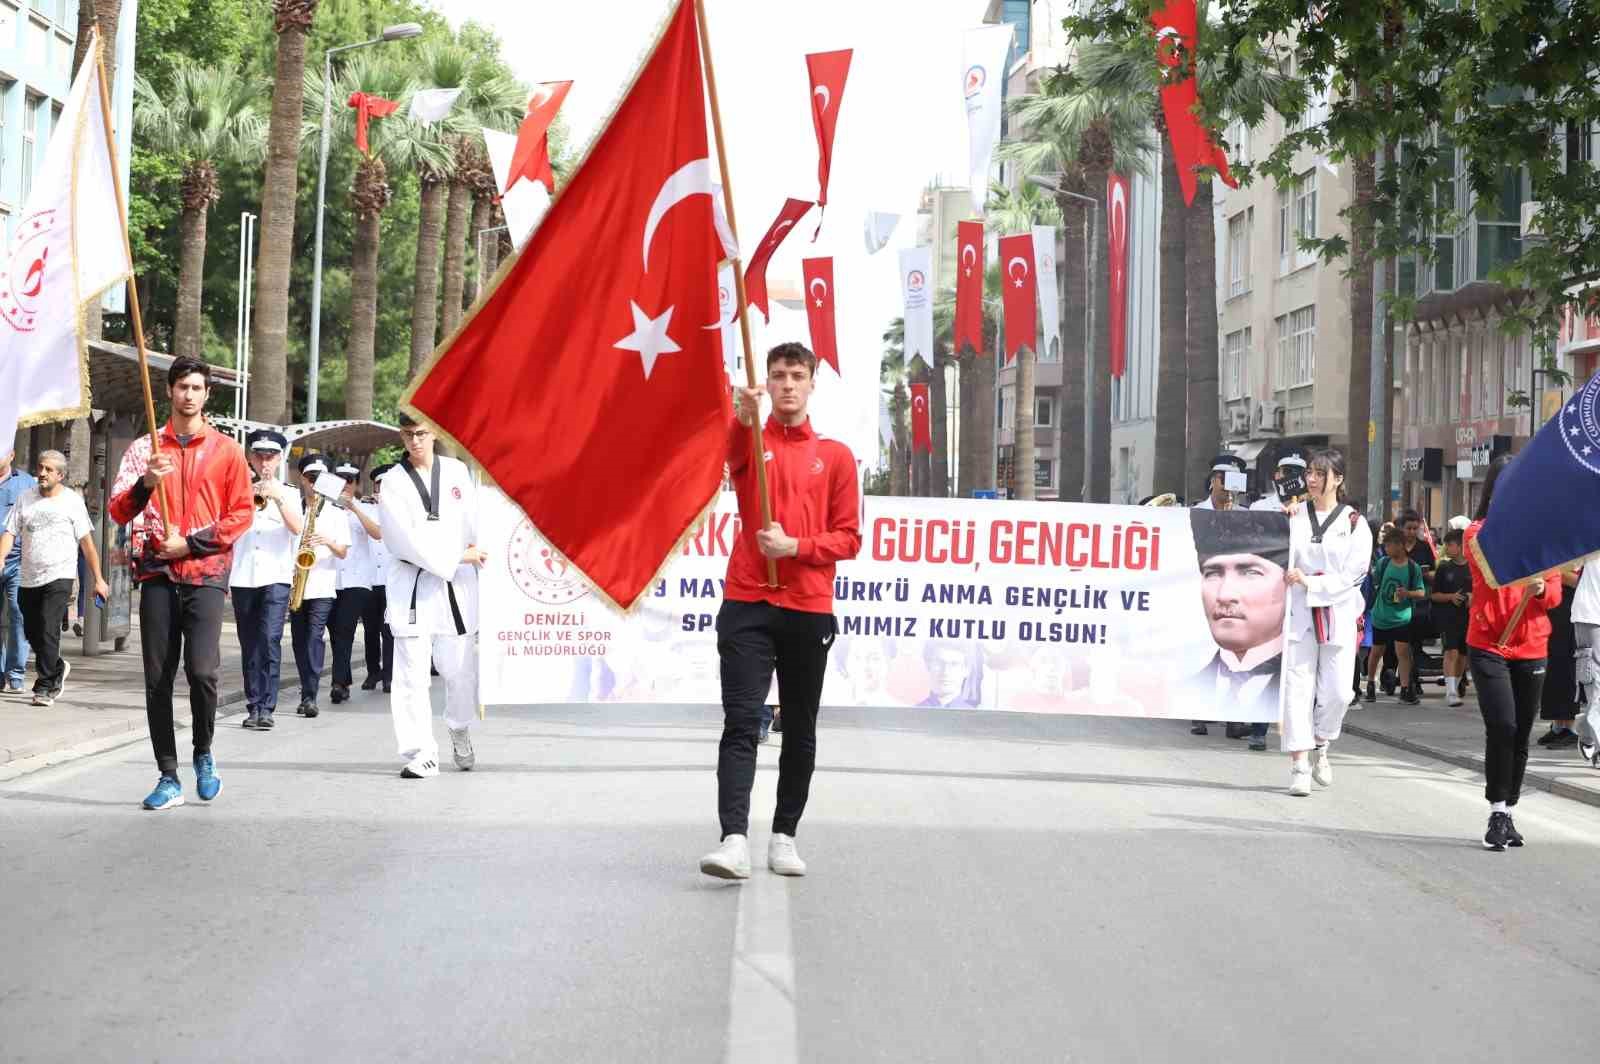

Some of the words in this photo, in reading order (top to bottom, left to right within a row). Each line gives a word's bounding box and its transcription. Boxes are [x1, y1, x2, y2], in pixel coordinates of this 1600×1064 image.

[872, 517, 980, 572] GÜCÜ,
[989, 519, 1160, 572] GENÇLİĞİ
[835, 576, 909, 602] ÜRK'Ü
[921, 583, 993, 605] ANMA
[1005, 584, 1108, 615] GENÇLİK
[1120, 590, 1150, 611] VE
[524, 612, 585, 626] DENİZLİ
[682, 613, 719, 632] SP
[836, 615, 917, 637] MIMIZ
[929, 618, 1006, 640] KUTLU
[1018, 621, 1107, 645] OLSUN!
[497, 629, 551, 644] GENÇLİK
[556, 630, 572, 641] VE
[577, 630, 612, 642] SPOR
[507, 645, 518, 657] İL
[523, 644, 607, 657] MÜDÜRLÜĞÜ
